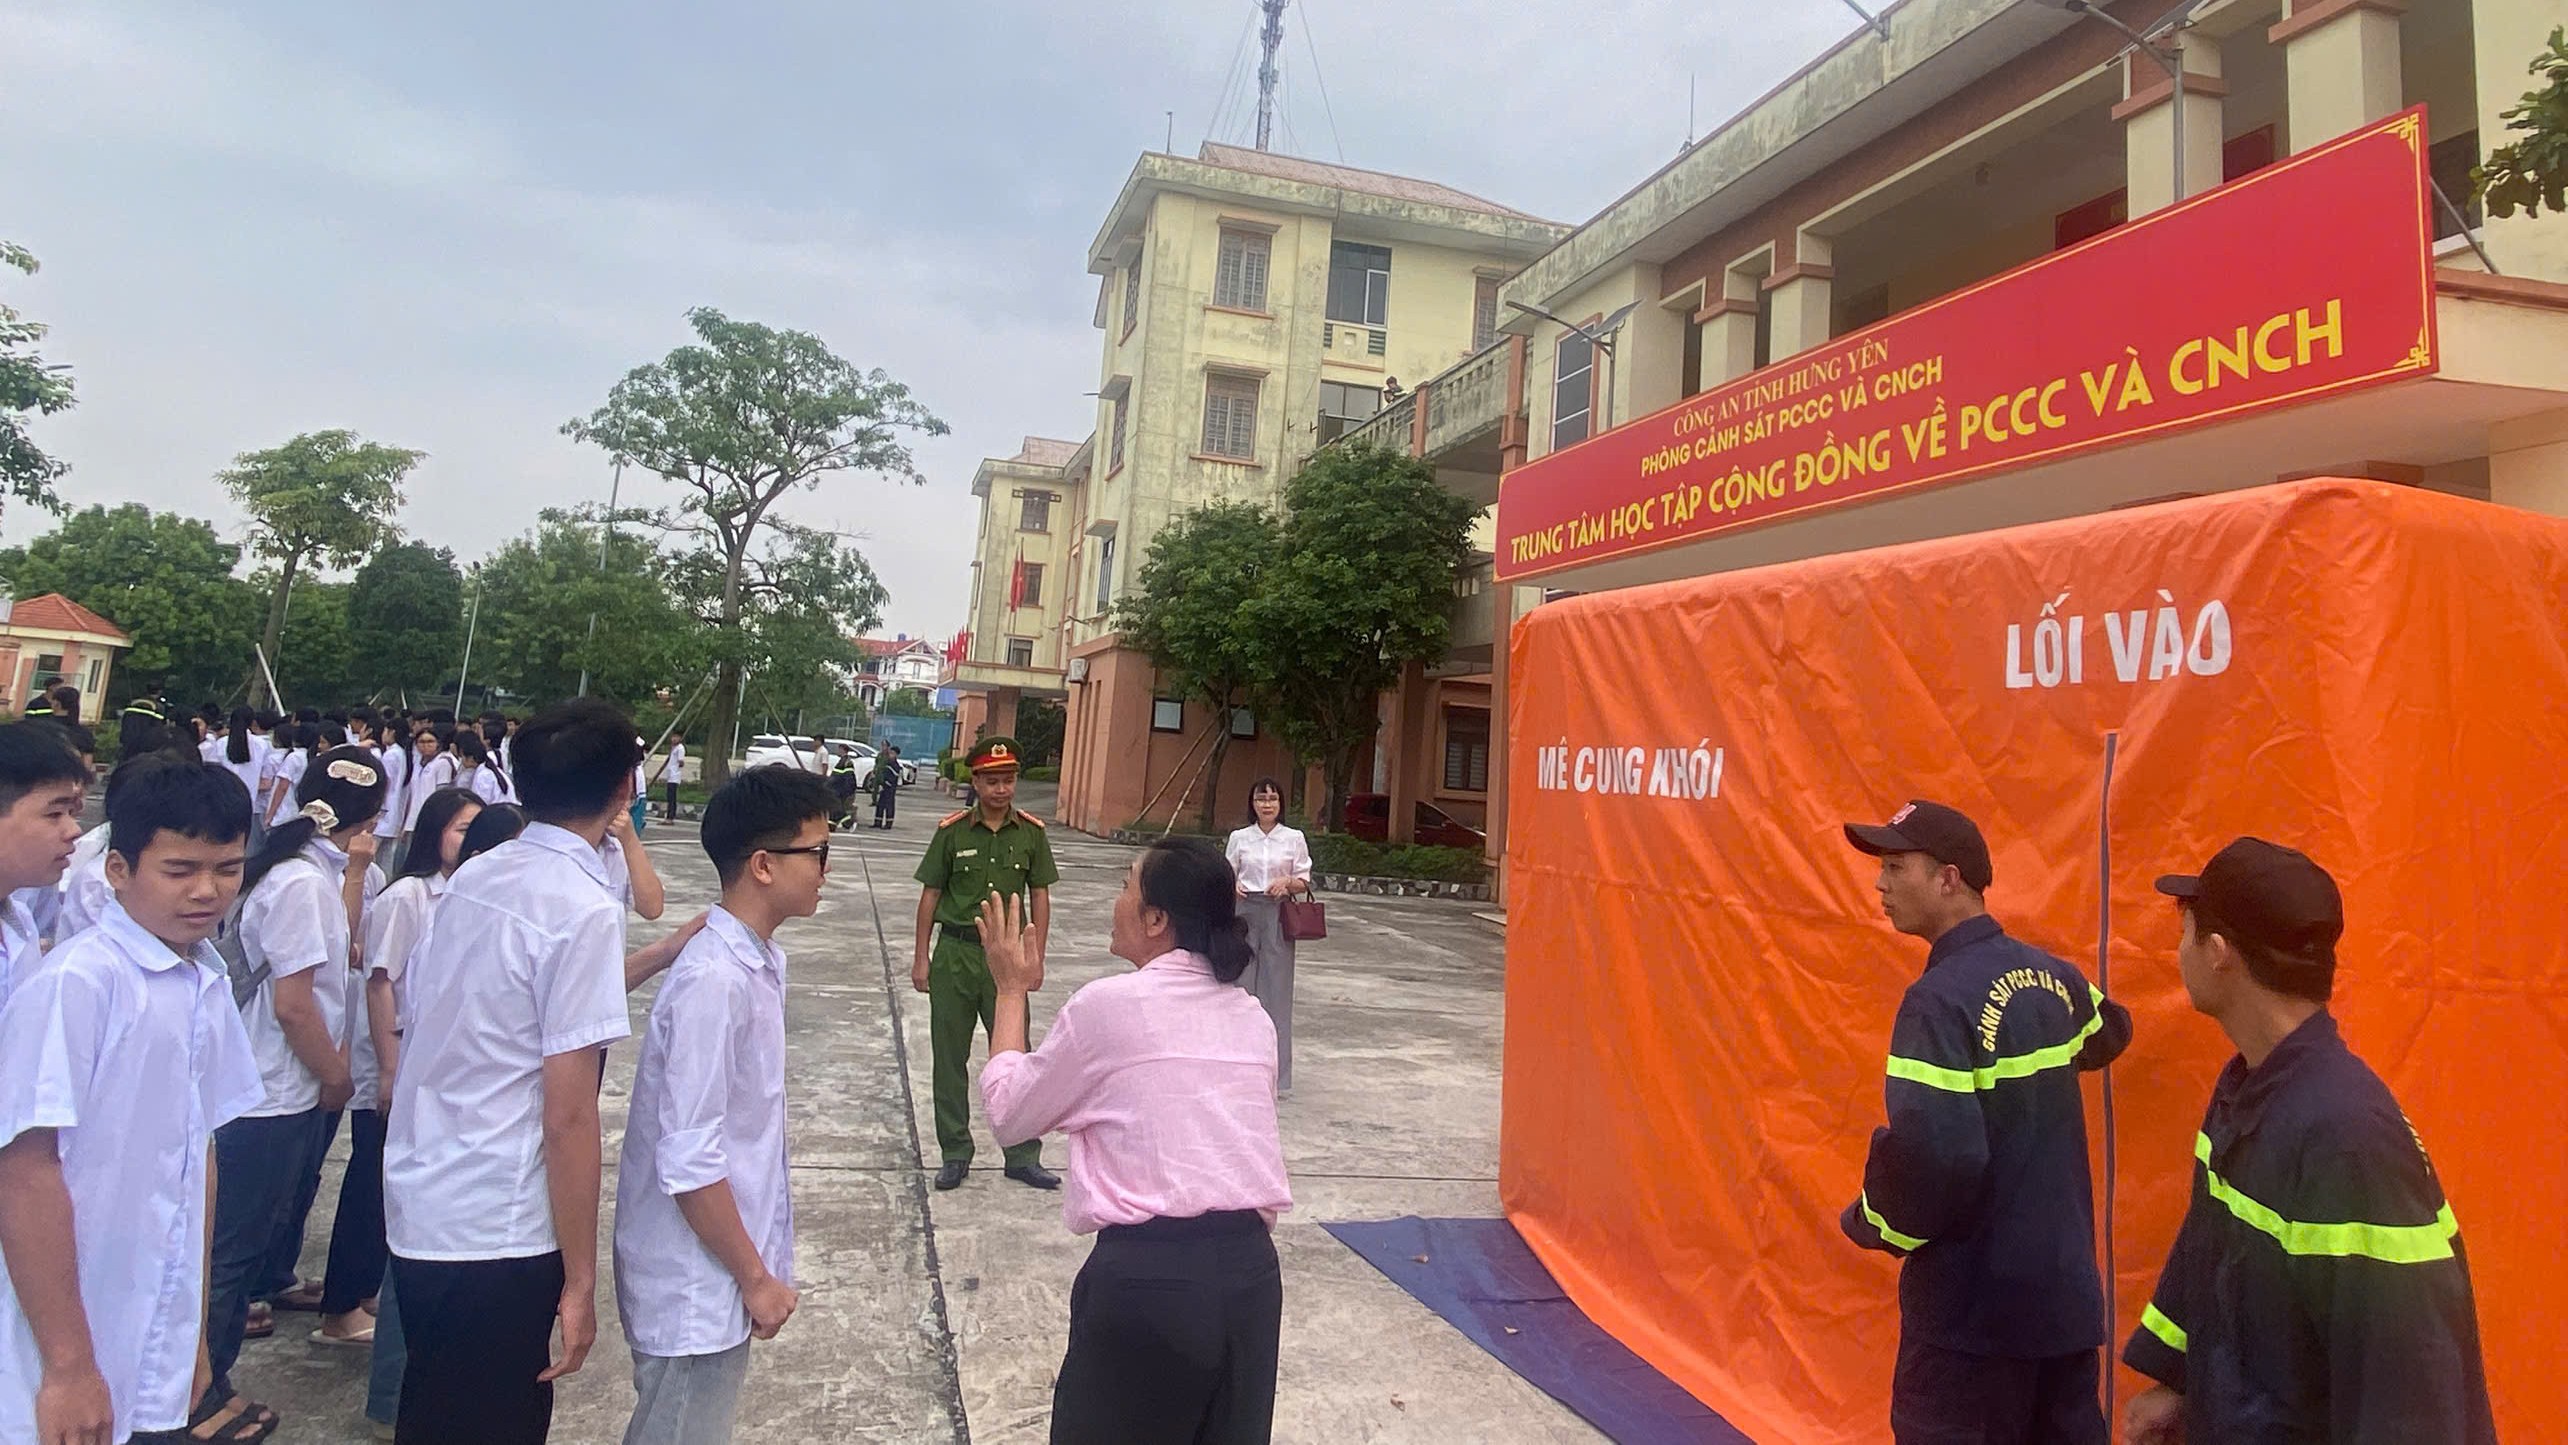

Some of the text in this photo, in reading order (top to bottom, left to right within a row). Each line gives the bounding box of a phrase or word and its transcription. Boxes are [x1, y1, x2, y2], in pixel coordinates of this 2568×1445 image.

[1511, 299, 2343, 565] TRUNG TÂM HỌC TẬP CỘNG ĐỒNG VỀ PCCC VÀ CNCH
[1641, 355, 1943, 477] PHÒNG CẢNH SÁT PCCC VÀ CNCH
[1673, 338, 1888, 437] CÔNG AN TỈNH HƯNG YÊN
[2005, 586, 2232, 688] LỐI VÀO
[1538, 736, 1724, 800] MÊ CUNG KHÓI
[2005, 968, 2038, 991] PCCC
